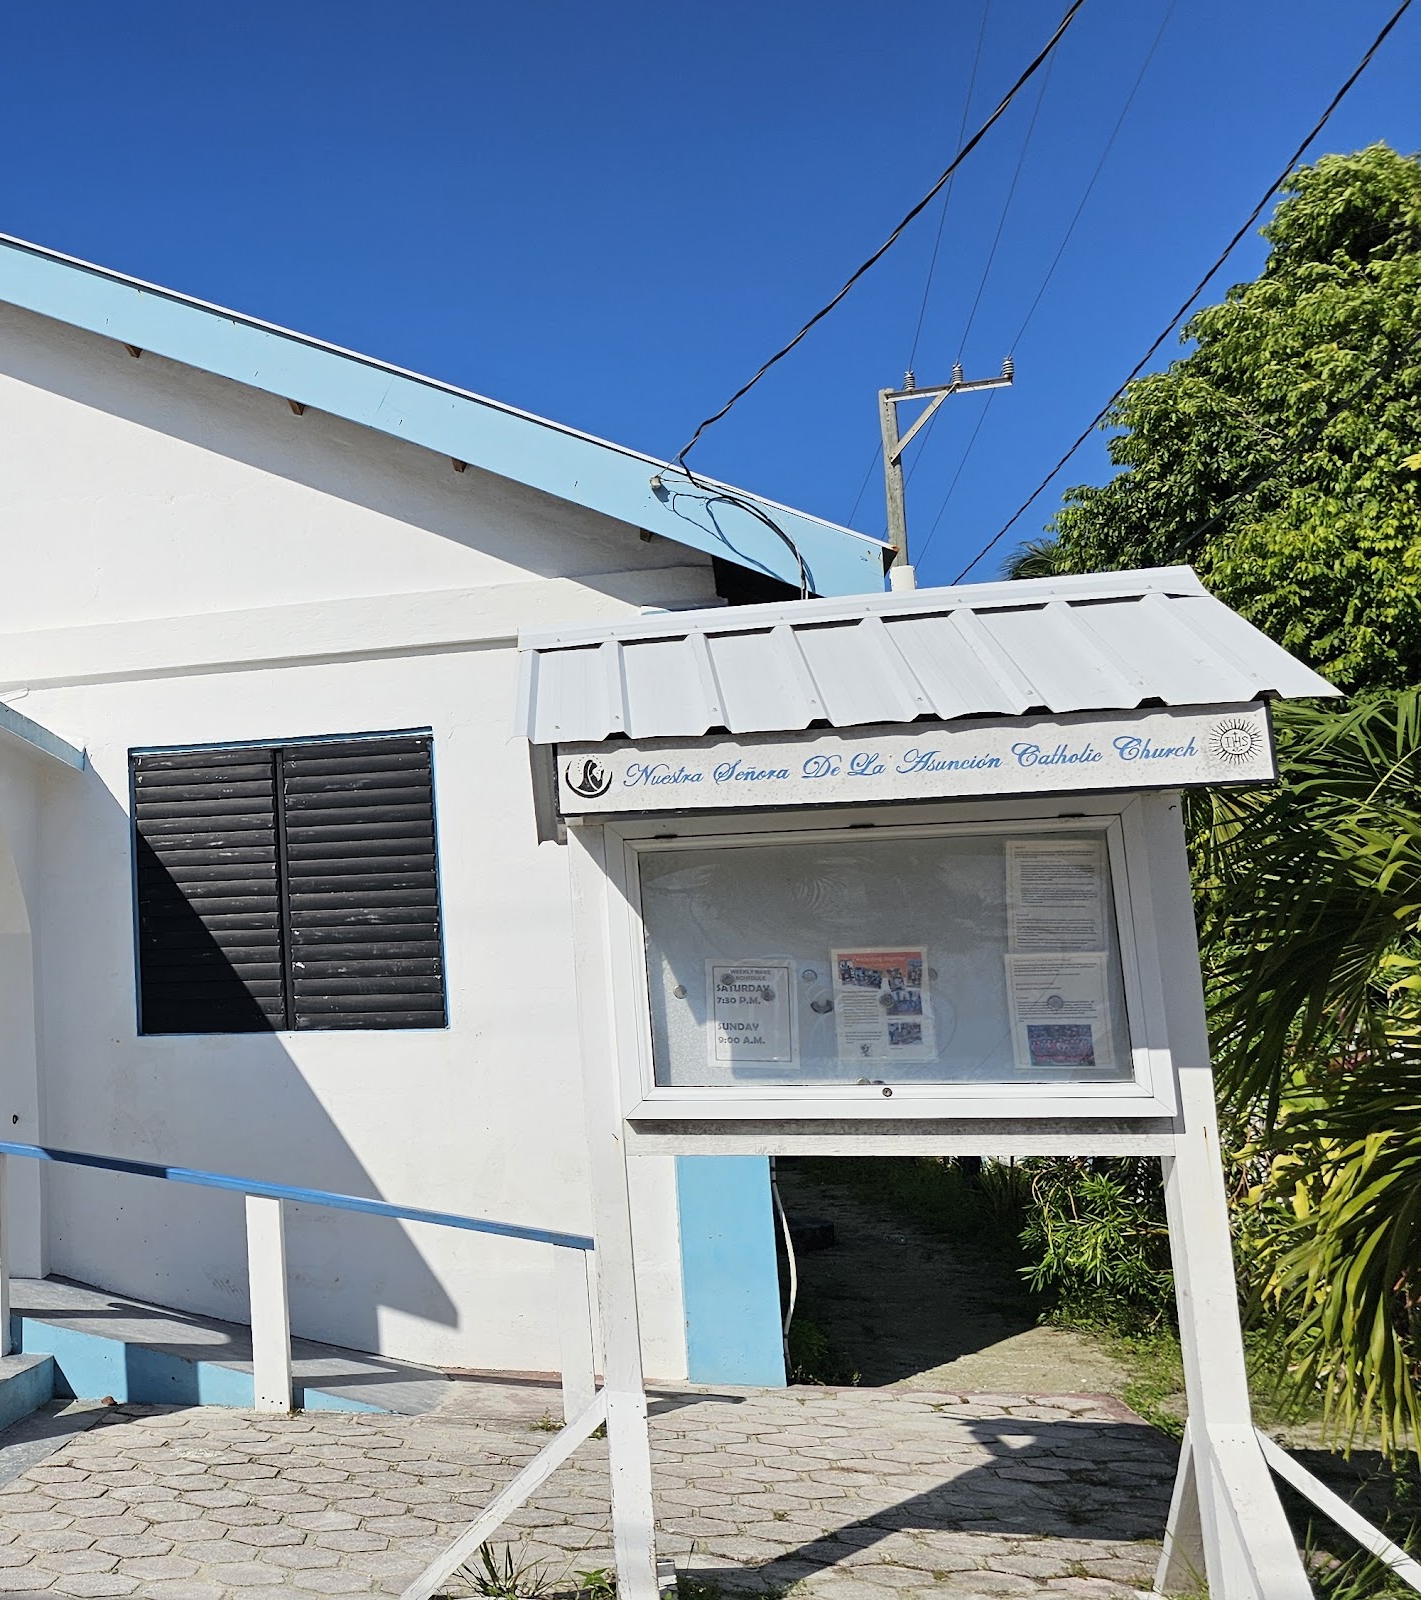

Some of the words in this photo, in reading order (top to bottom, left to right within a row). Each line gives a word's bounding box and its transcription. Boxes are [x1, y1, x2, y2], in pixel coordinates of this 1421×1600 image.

[1224, 732, 1249, 748] IHS
[623, 763, 704, 787] Nuestra
[713, 759, 790, 785] Señora
[801, 754, 842, 779] De
[847, 752, 886, 777] La
[896, 748, 1003, 774] Asunción
[1011, 742, 1103, 767] Catholic
[1113, 736, 1199, 761] Church
[716, 984, 770, 993] SATURDAY
[739, 997, 761, 1005] P.M.
[717, 1022, 759, 1031] SUNDAY
[718, 1036, 740, 1044] 9:00
[743, 1036, 766, 1045] A.M.
